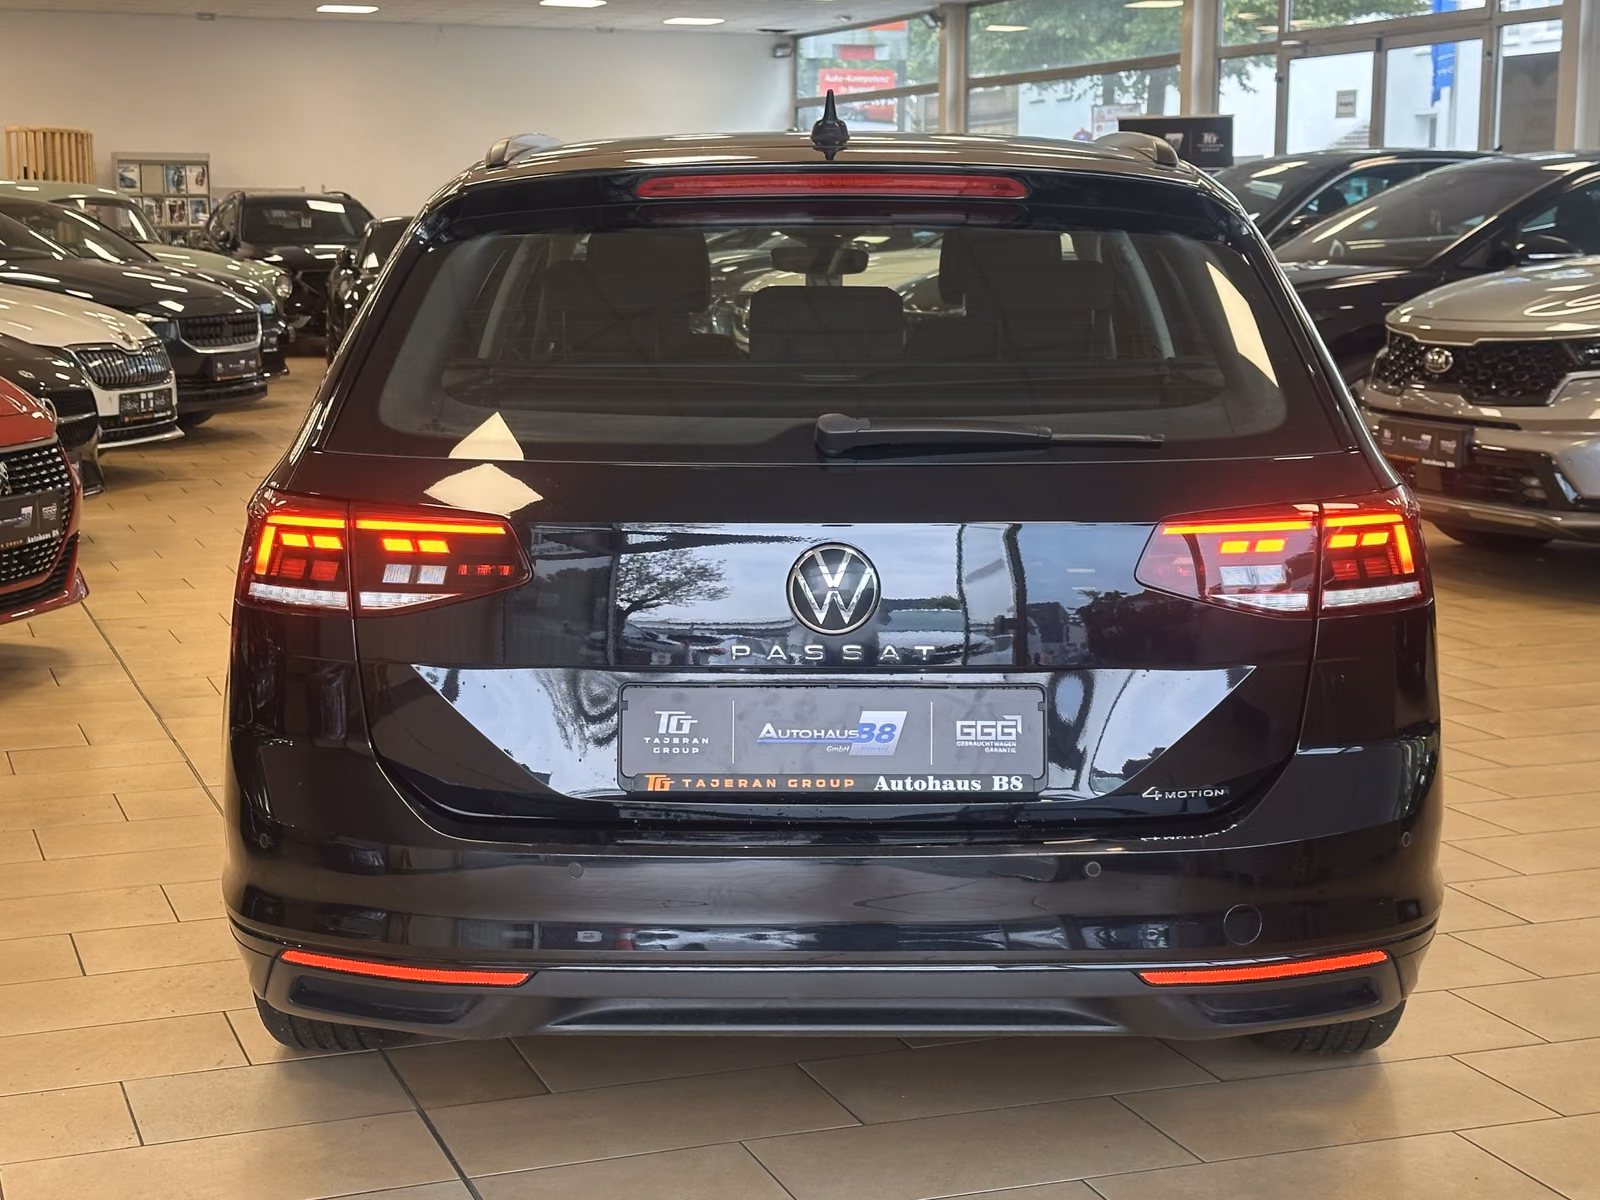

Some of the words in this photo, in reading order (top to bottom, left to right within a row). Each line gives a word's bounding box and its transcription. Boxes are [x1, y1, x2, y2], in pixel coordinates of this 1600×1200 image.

[731, 644, 936, 661] PASSAT
[956, 720, 1017, 741] GGG
[826, 745, 850, 753] GmbH
[682, 778, 776, 788] TAJERAN
[788, 778, 855, 788] GROUP
[874, 775, 982, 791] Autohaus
[992, 775, 1023, 791] B8
